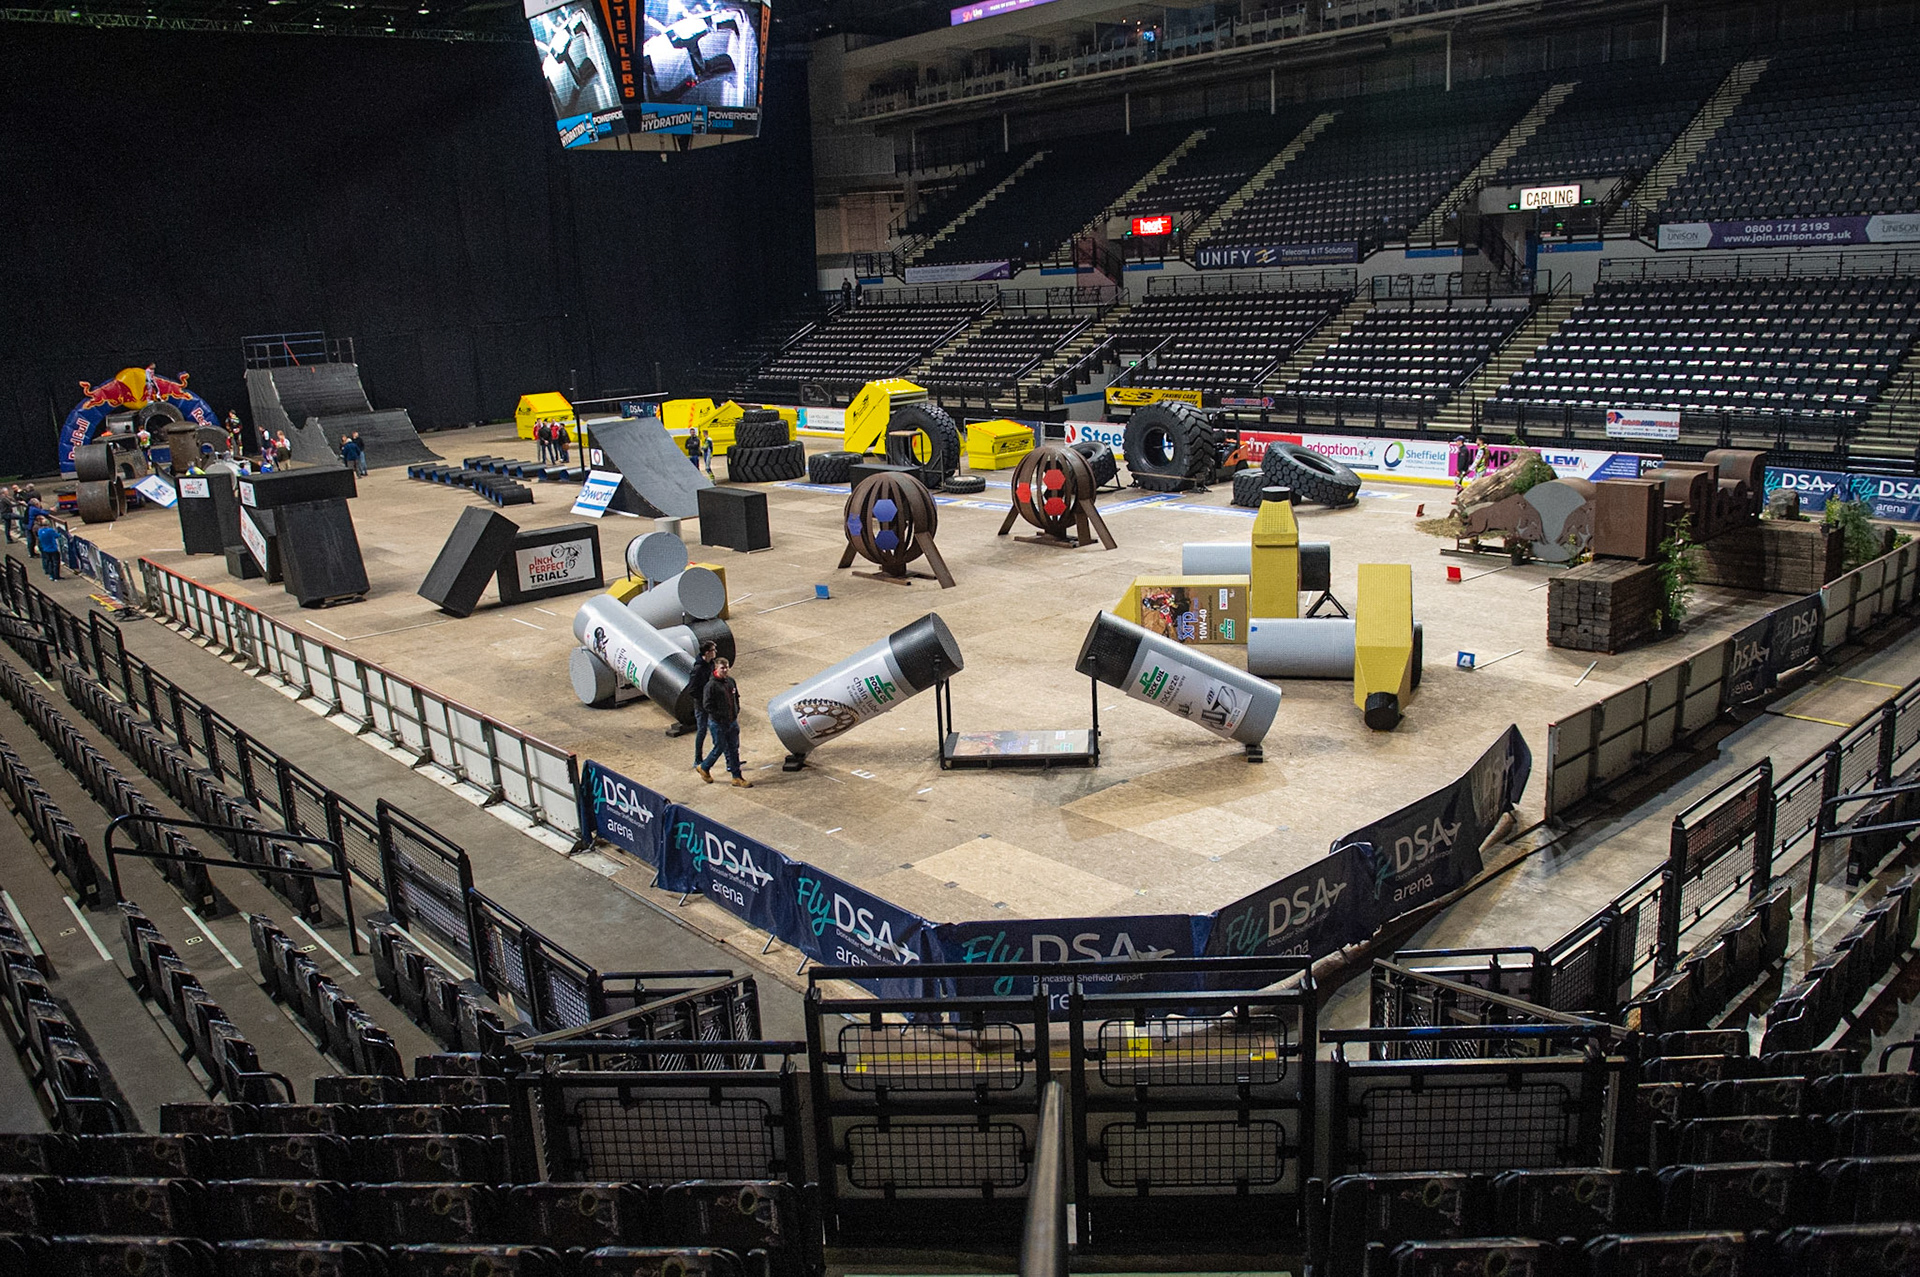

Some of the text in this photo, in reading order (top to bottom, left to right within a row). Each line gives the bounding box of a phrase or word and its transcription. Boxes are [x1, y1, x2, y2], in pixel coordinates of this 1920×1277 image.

[613, 0, 636, 98] TEELERS
[592, 110, 625, 125] POWERADE
[641, 112, 692, 132] HYDRATION
[708, 111, 758, 121] POWERADE
[561, 121, 587, 148] HYDRATION
[1526, 189, 1573, 207] CARLING
[1667, 232, 1699, 241] UNISON
[1724, 230, 1852, 243] www.join.unison.org.uk
[1744, 222, 1830, 233] 0800 171 2193
[1881, 223, 1919, 233] UNISON
[1200, 249, 1250, 266] UNIFY
[1324, 246, 1354, 254] Solutions
[73, 418, 90, 439] Bull
[1081, 426, 1125, 447] Stee
[1406, 450, 1446, 460] Sheffield
[1545, 455, 1580, 465] LEW
[1641, 460, 1658, 468] FRO
[1782, 473, 1825, 491] DSA
[1850, 478, 1920, 500] Fly DSA
[1876, 502, 1906, 514] arena
[529, 561, 565, 574] PERFECT
[534, 556, 553, 566] INCH
[530, 569, 569, 583] TRIALS
[1182, 612, 1198, 639] xrp
[1199, 609, 1207, 639] 10W-40
[1792, 608, 1818, 639] DSA
[1459, 654, 1471, 667] 4
[1790, 645, 1810, 660] arena
[869, 676, 882, 695] ROCK
[1146, 670, 1165, 698] ROCK OIL
[1160, 674, 1180, 704] rockeze
[853, 677, 868, 700] chain
[866, 700, 879, 713] lube
[603, 775, 645, 822] DSA
[607, 818, 635, 842] arena
[675, 822, 758, 886] Fly DSA
[1395, 817, 1452, 873] DSA
[712, 879, 744, 906] arena
[1393, 873, 1434, 902] arena
[797, 877, 901, 962] Fly DSA
[1226, 877, 1331, 956] Fly DSA
[836, 928, 860, 948] Doncaster
[860, 943, 881, 961] Sheffield
[1280, 939, 1309, 957] ena
[836, 945, 869, 966] aren
[962, 931, 1140, 996] Fly DSA
[1077, 974, 1113, 982] Sheffield
[1115, 973, 1144, 983] Airport
